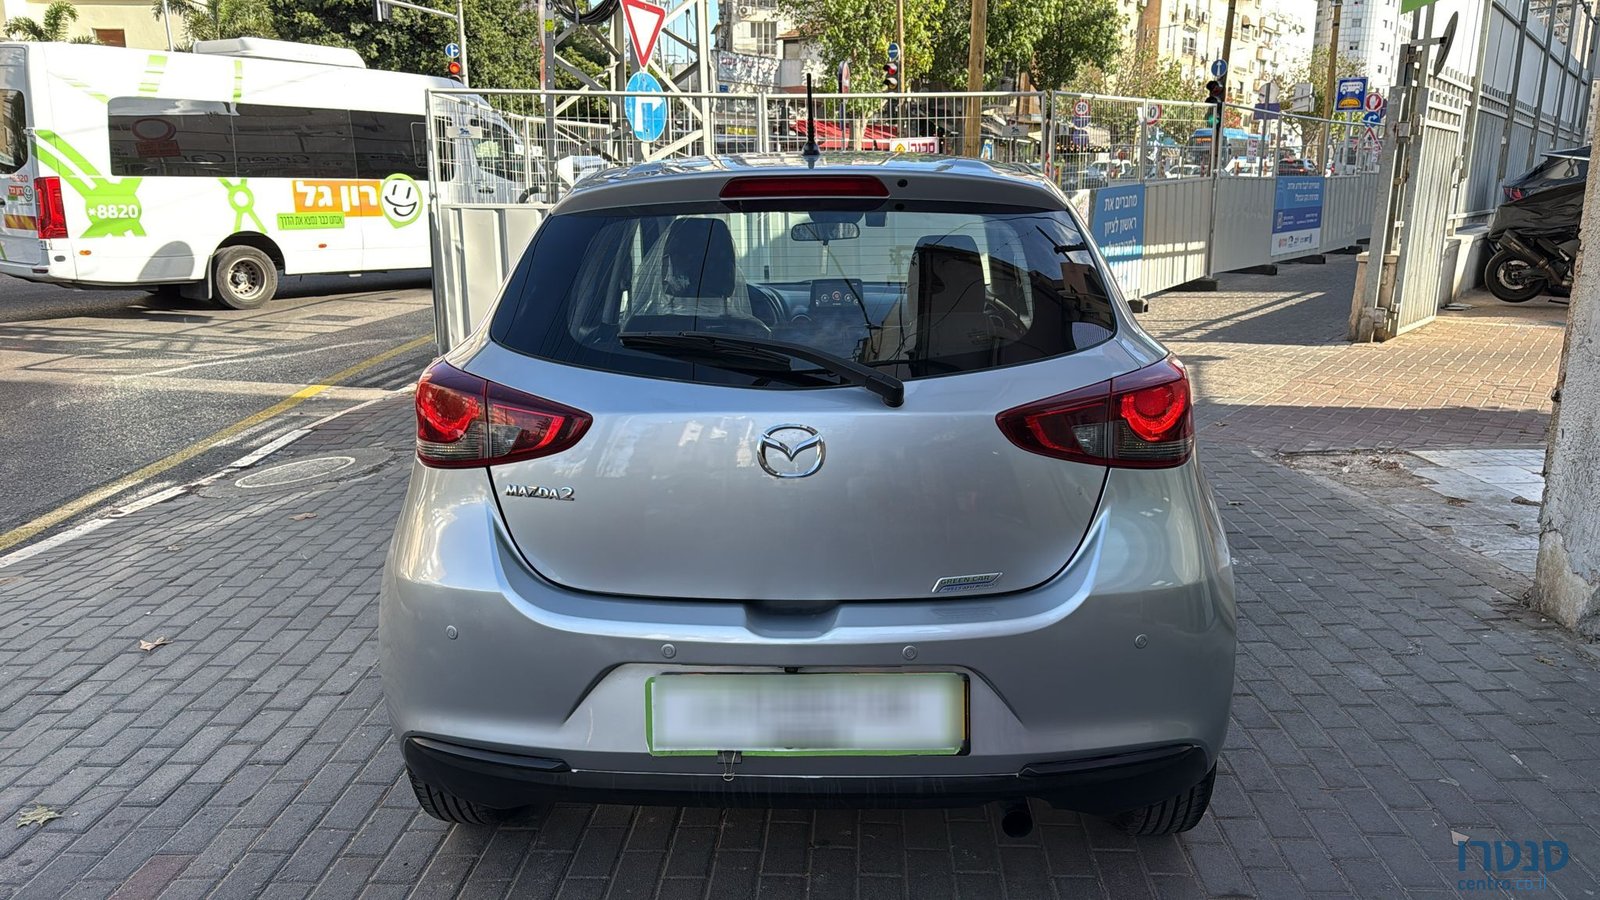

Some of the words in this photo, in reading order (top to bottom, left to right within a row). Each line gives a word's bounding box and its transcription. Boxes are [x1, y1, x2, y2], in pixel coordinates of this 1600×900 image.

[1076, 103, 1087, 112] 50
[295, 180, 334, 207] גל
[340, 185, 378, 212] רון
[1104, 197, 1114, 212] את
[1115, 194, 1138, 210] מחברים
[1104, 216, 1119, 237] לציון
[1120, 217, 1137, 234] ראשון
[940, 577, 970, 585] GREEN
